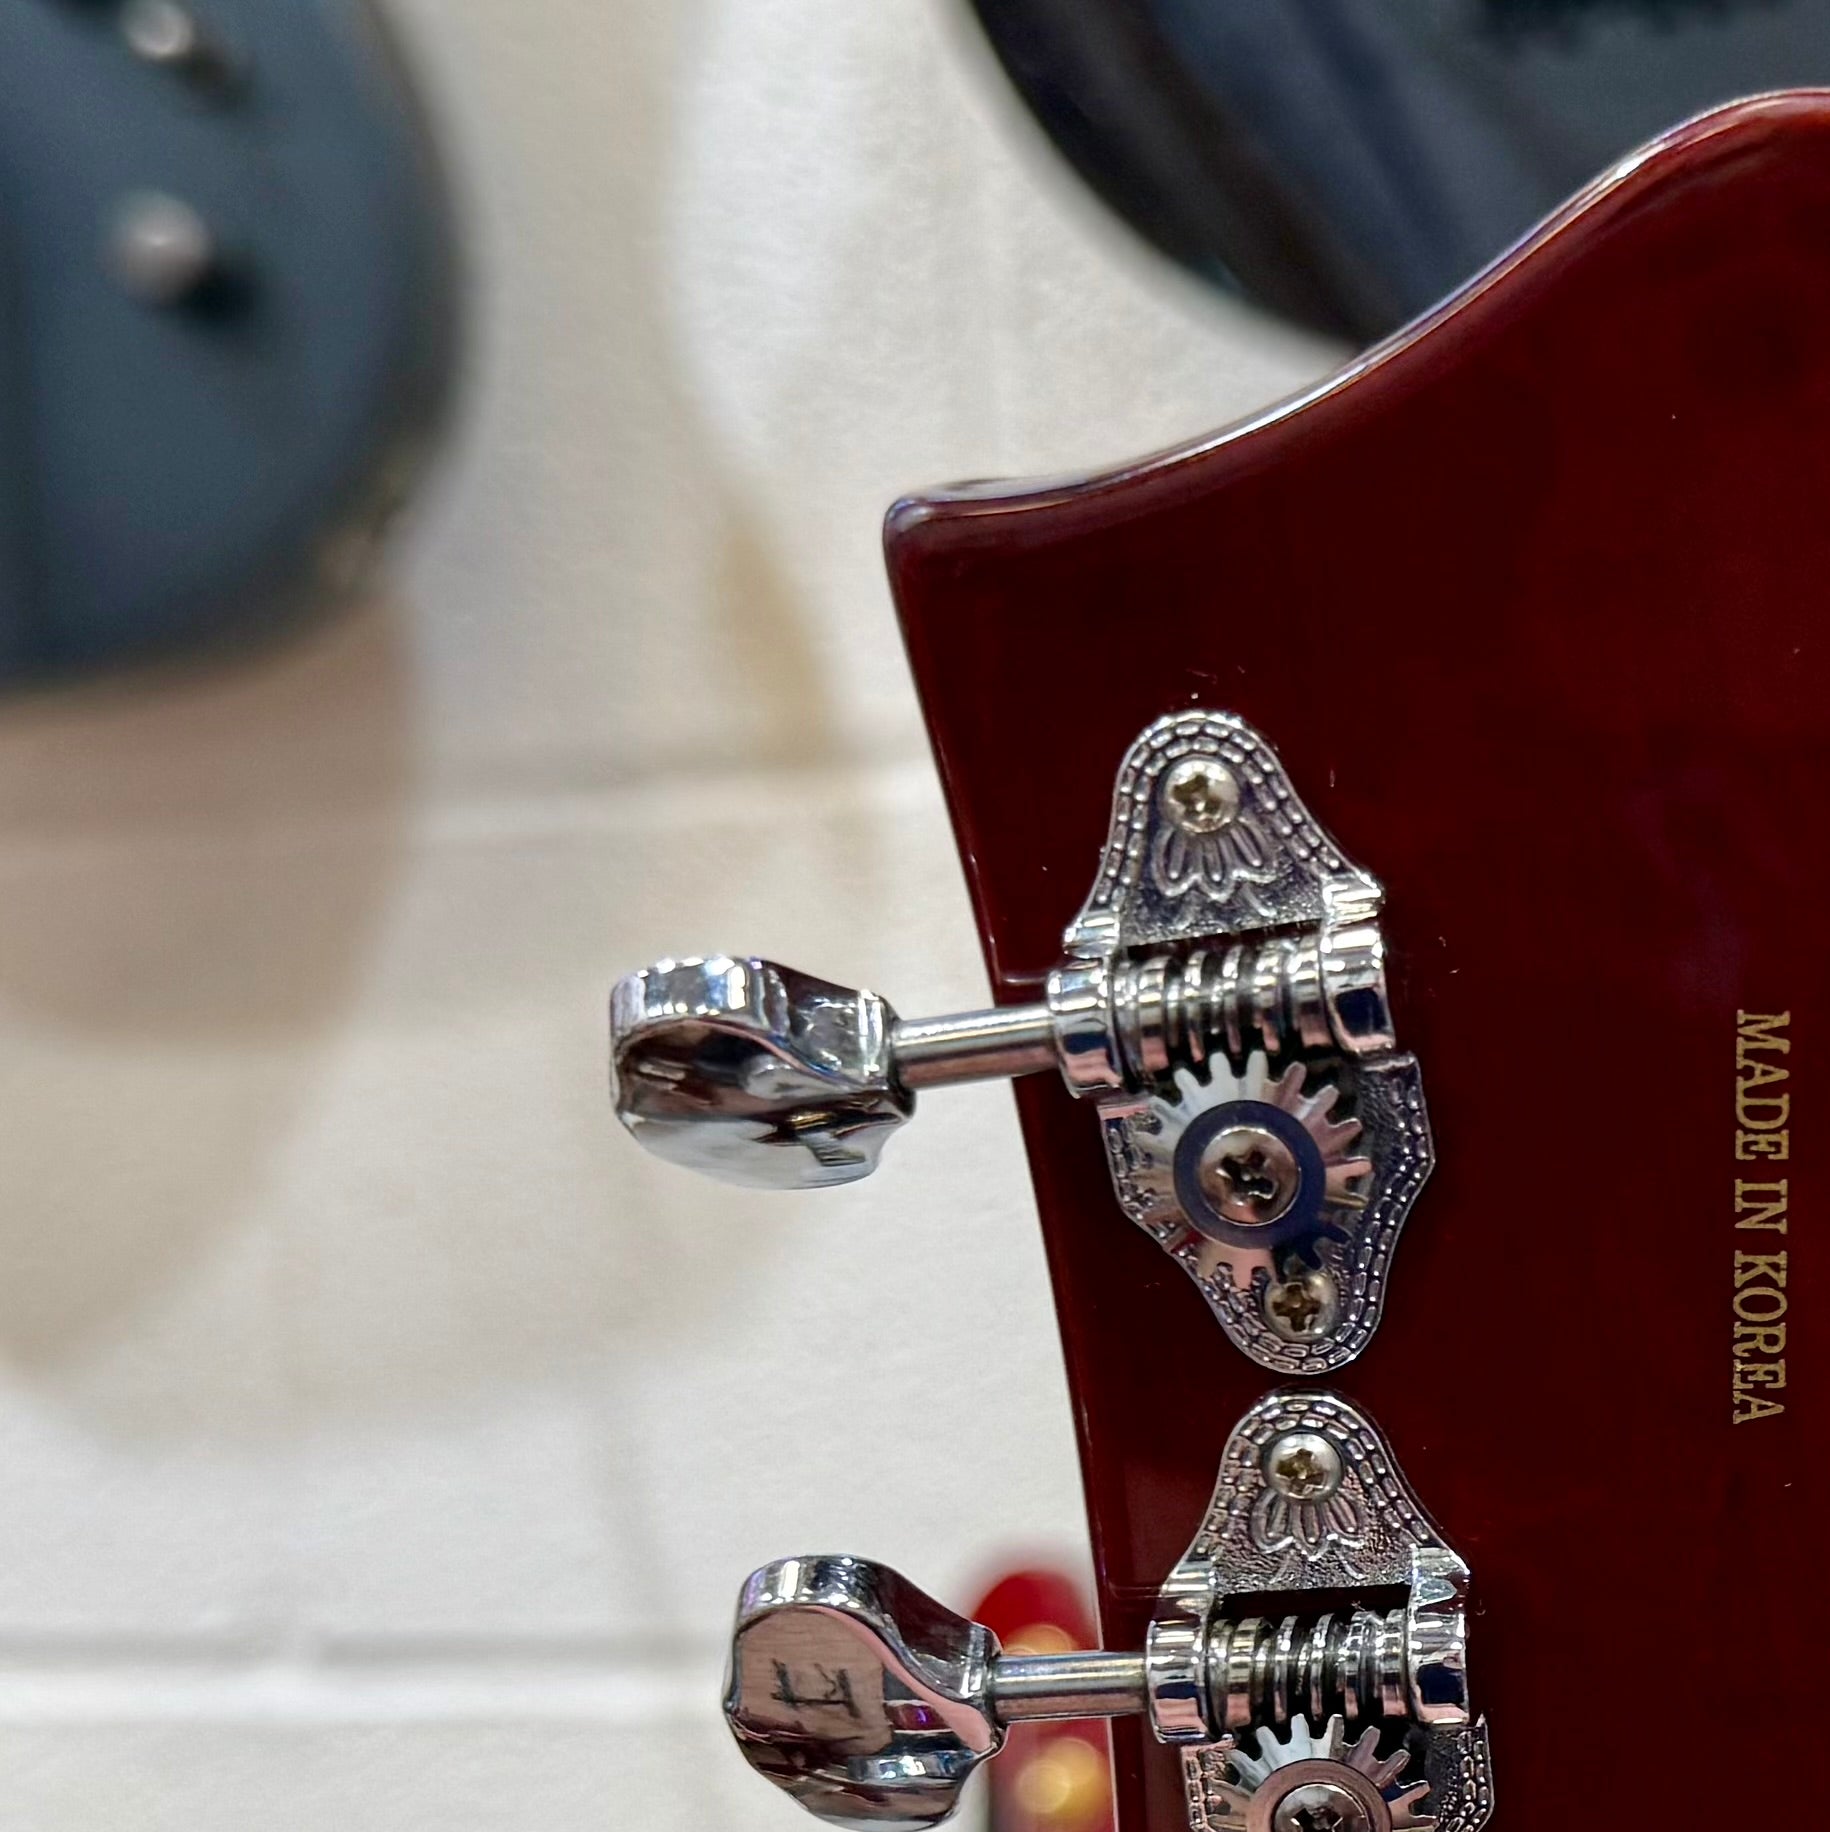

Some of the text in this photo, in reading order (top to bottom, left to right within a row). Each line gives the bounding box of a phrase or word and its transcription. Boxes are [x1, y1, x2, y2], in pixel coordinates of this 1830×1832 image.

[1731, 1008, 1791, 1425] MADE IN KOREA
